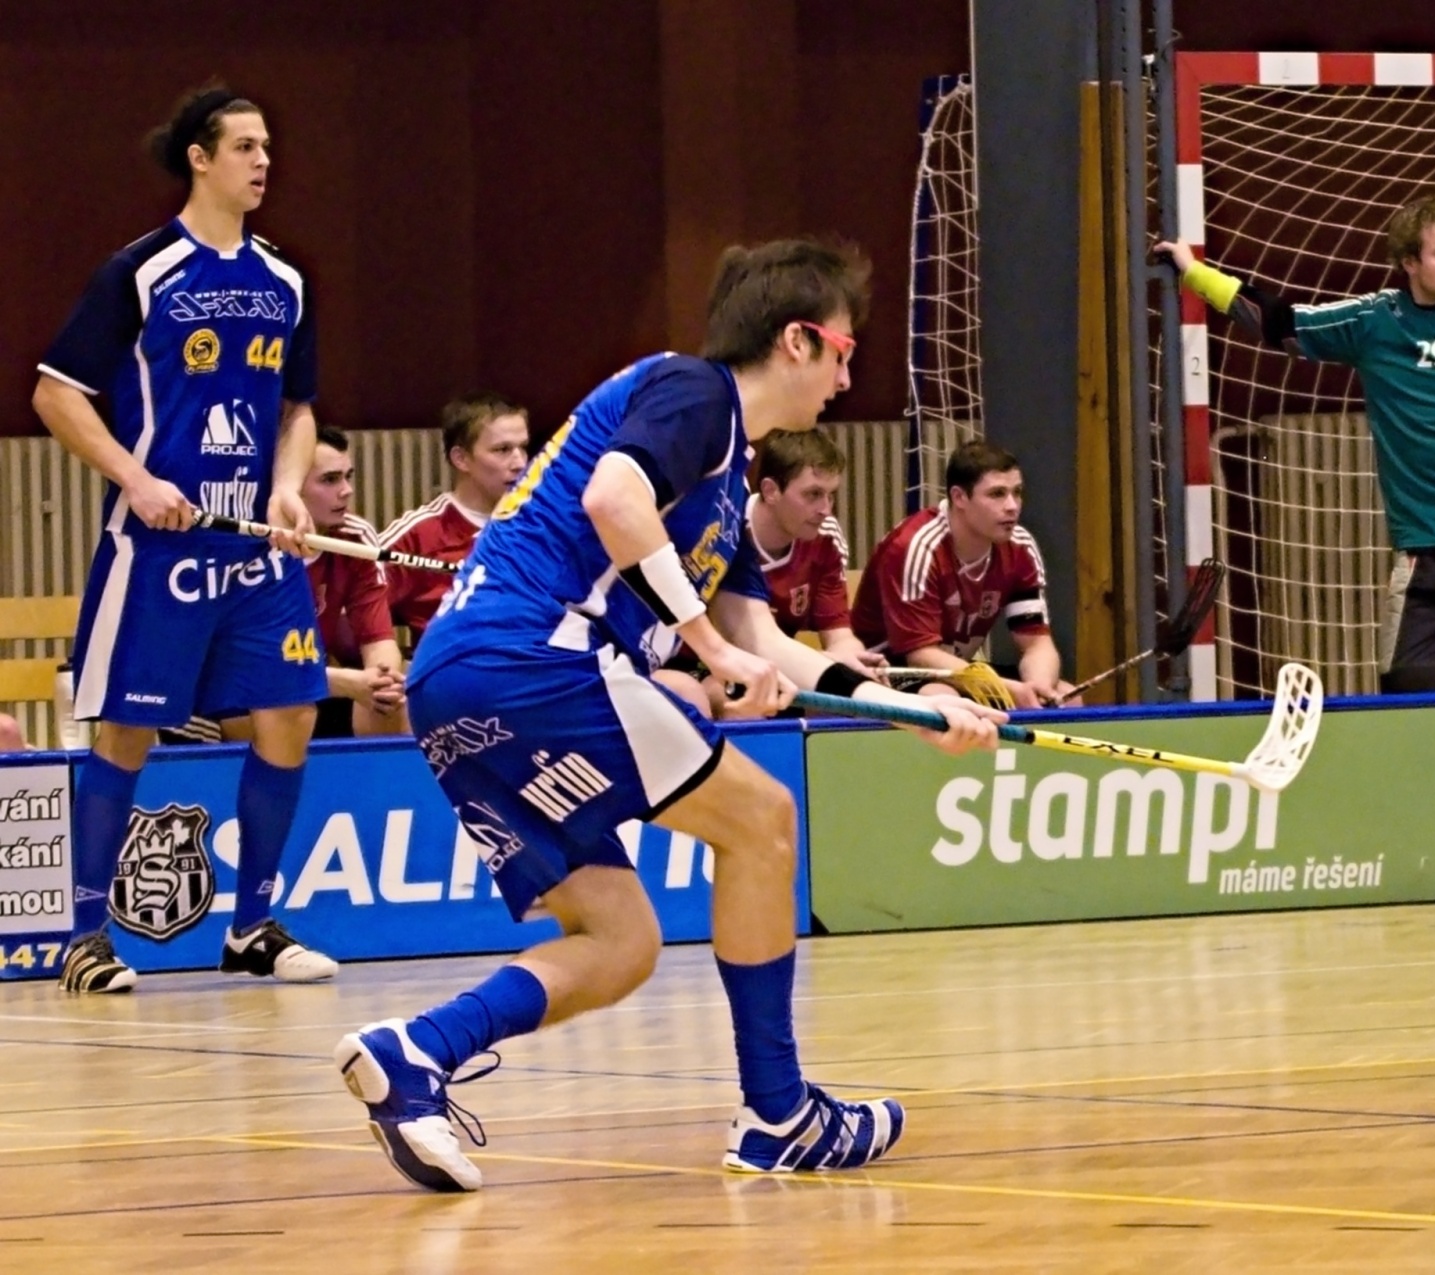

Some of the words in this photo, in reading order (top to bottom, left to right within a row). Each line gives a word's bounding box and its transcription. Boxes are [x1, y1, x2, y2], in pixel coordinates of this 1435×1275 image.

[246, 334, 284, 374] 44
[1191, 356, 1200, 376] 2
[281, 627, 320, 666] 44
[1218, 860, 1297, 895] máme
[1302, 853, 1386, 891] řešení
